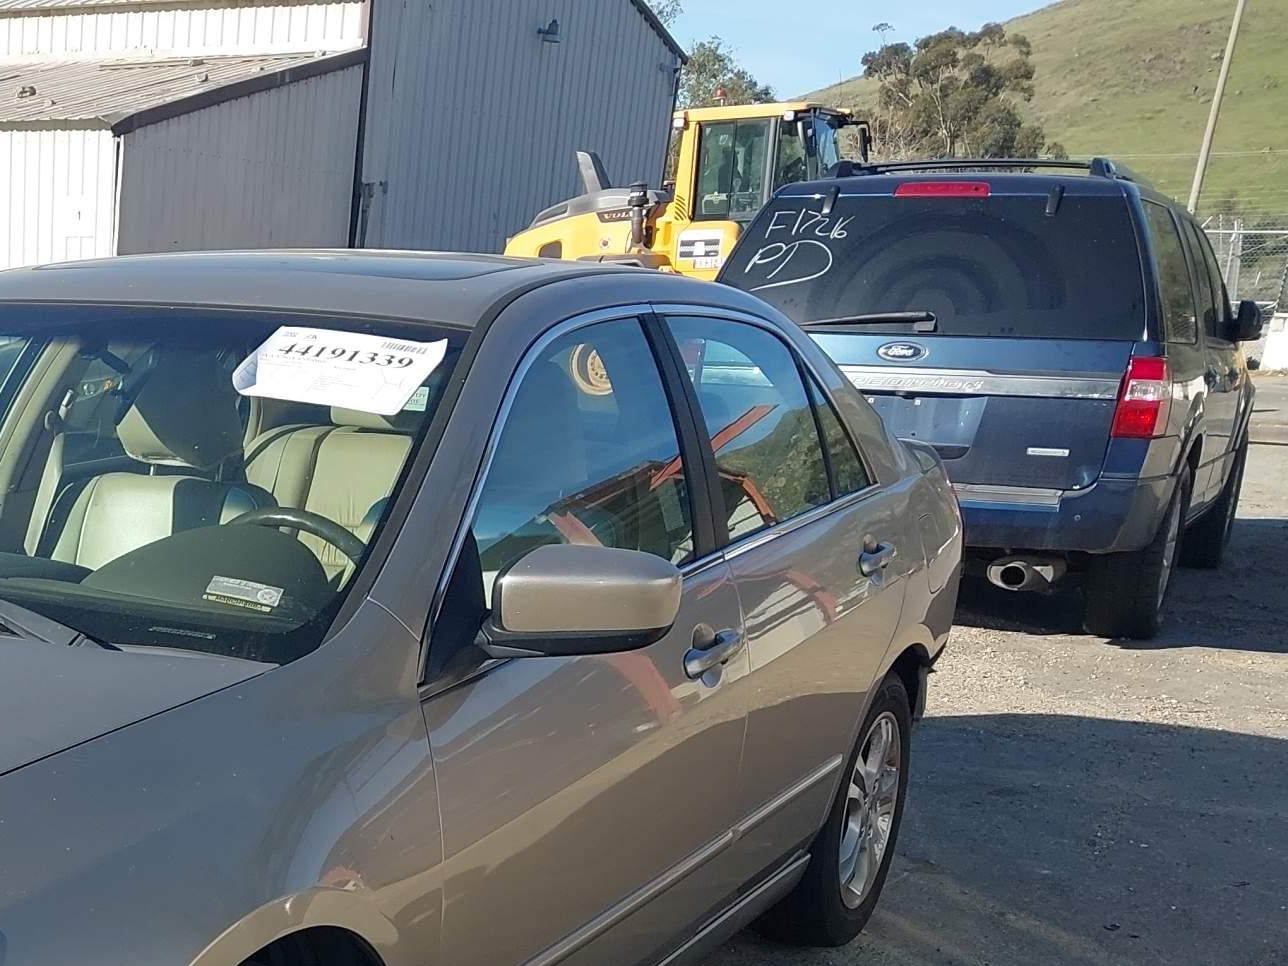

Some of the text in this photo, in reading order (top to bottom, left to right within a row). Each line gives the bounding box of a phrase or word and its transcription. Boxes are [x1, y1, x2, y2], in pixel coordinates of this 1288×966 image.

[277, 342, 414, 369] 44191339
[887, 345, 914, 357] Ford
[852, 375, 985, 391] PEDITION
